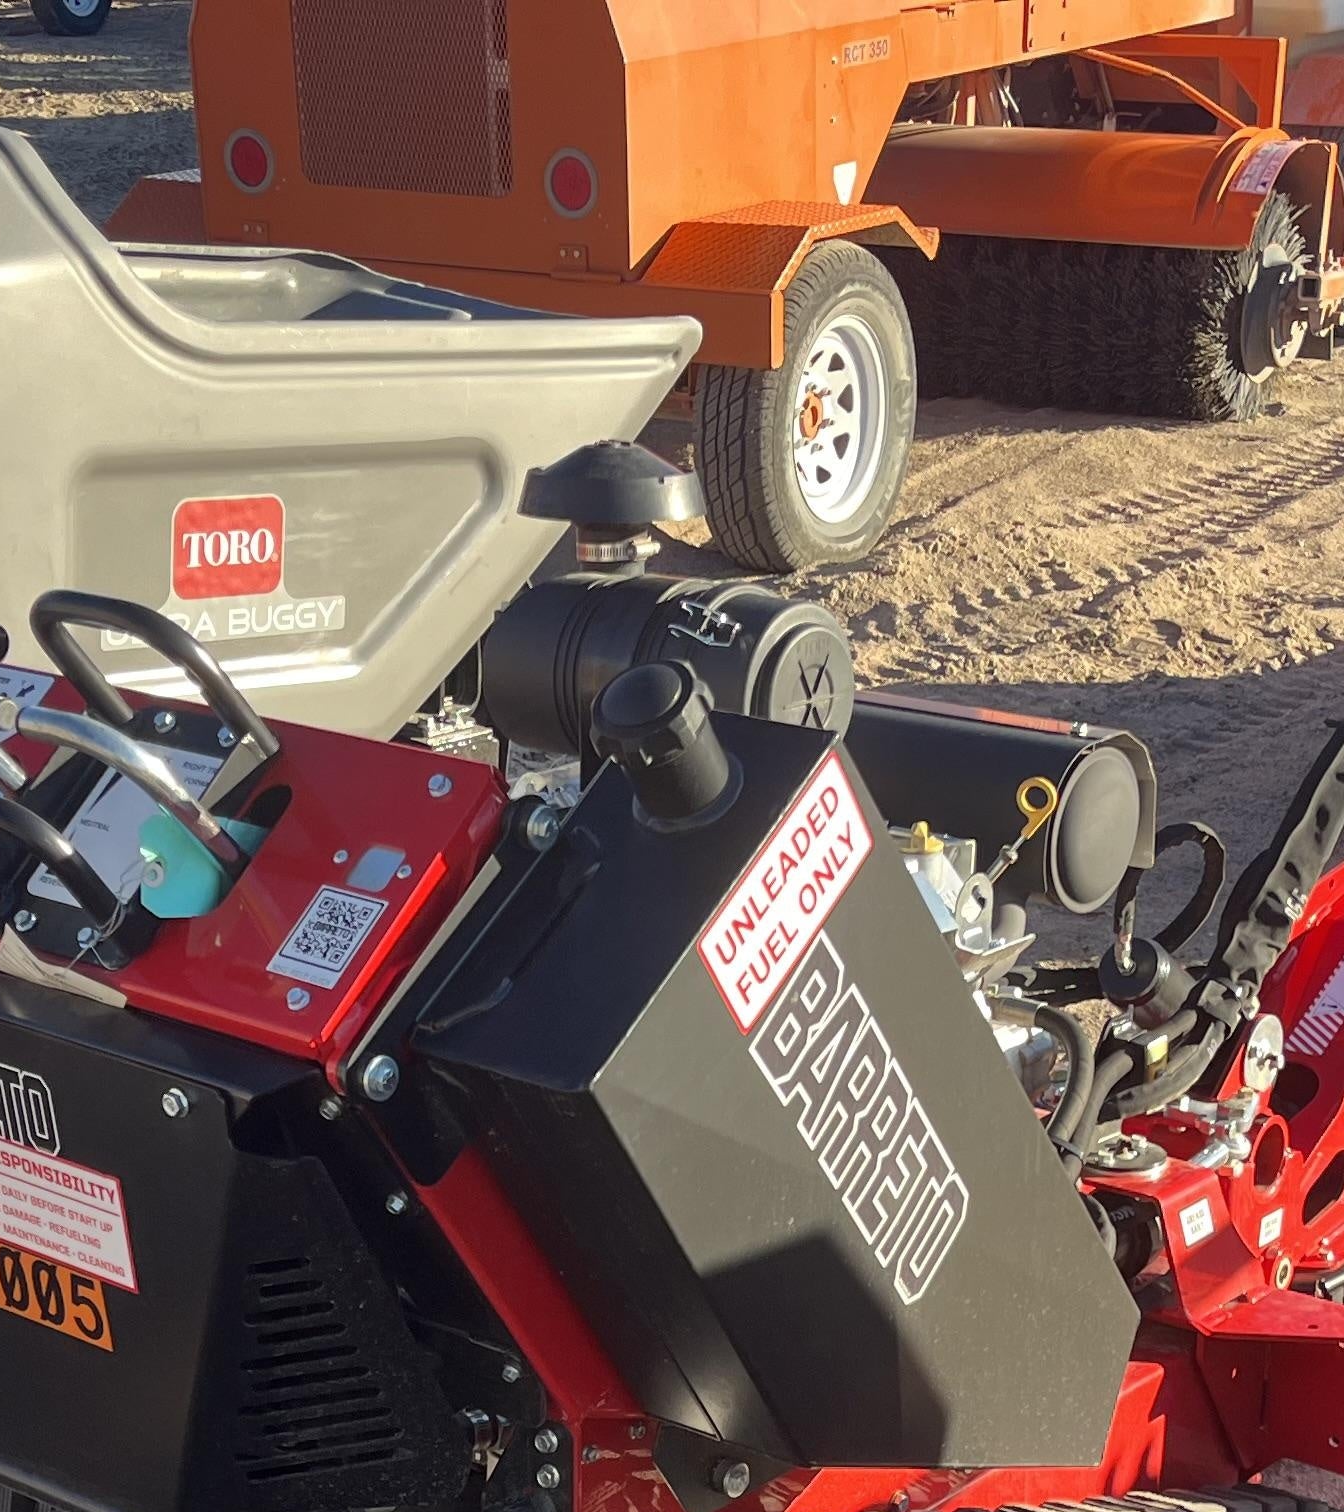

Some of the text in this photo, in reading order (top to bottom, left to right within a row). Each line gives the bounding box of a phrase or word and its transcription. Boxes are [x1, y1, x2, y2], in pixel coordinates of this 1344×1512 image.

[843, 39, 888, 64] RCT 350
[183, 528, 276, 568] TORO
[228, 600, 340, 636] BUGGY
[714, 786, 840, 965] UNLEADED
[736, 822, 857, 1005] FUEL ONLY
[748, 930, 970, 1305] BARRETO
[1, 1184, 28, 1202] DAILY
[31, 1195, 66, 1218] BEFORE
[68, 1209, 98, 1228] START
[99, 1221, 113, 1233] UP
[3, 1204, 42, 1227] DAMAGE
[49, 1221, 102, 1250] REFUELING
[2, 1221, 72, 1257] MAINTENANCE
[77, 1251, 126, 1278] CLEANING
